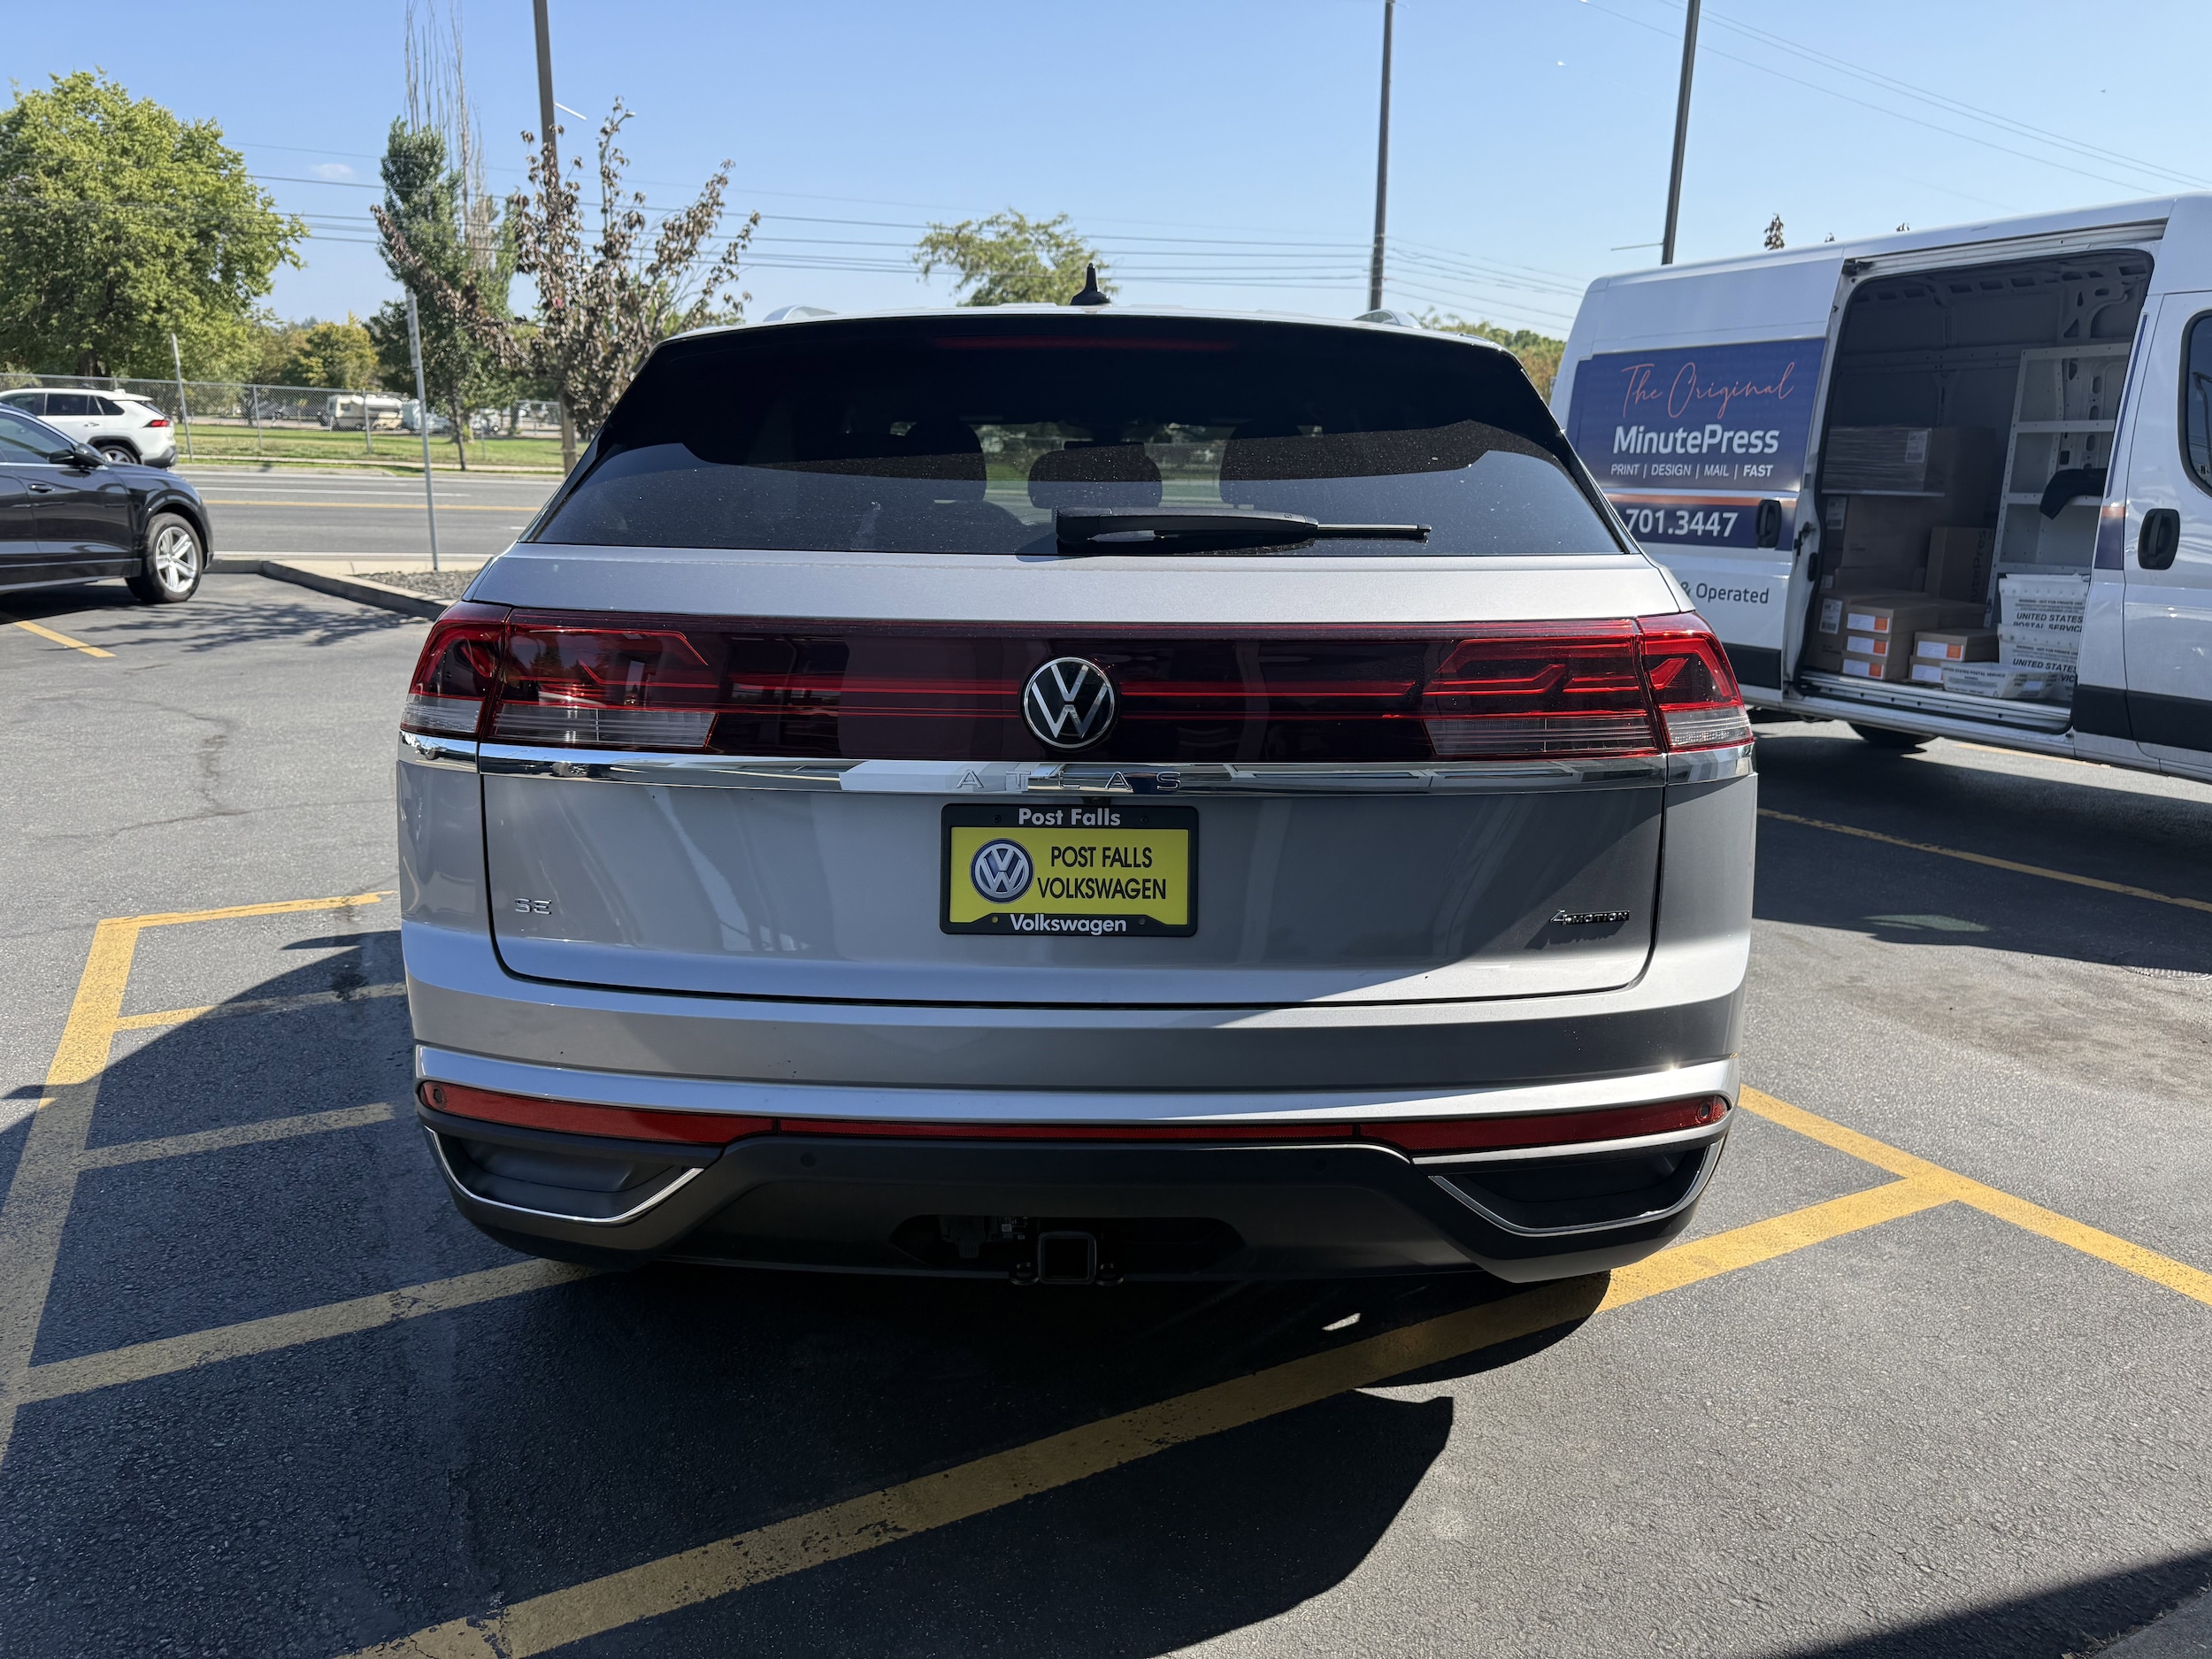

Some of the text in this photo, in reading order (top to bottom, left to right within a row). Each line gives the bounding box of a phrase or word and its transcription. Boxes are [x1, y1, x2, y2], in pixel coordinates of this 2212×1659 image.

[1621, 361, 1795, 419] The Original
[1612, 423, 1780, 455] MinutePress
[1610, 463, 1774, 478] PRINT DESIGN MAIL FAST
[1625, 508, 1739, 538] 701.3447
[1695, 582, 1770, 603] Operated
[2016, 611, 2084, 624] UNITED STATES
[2012, 657, 2044, 669] UNITED
[956, 768, 1182, 790] ATLAS
[1018, 808, 1121, 826] Post Falls
[1050, 846, 1153, 868] POST FALLS
[1037, 877, 1166, 900] VOLKSWAGEN
[515, 897, 552, 914] SE
[1010, 913, 1126, 935] Volkswagen
